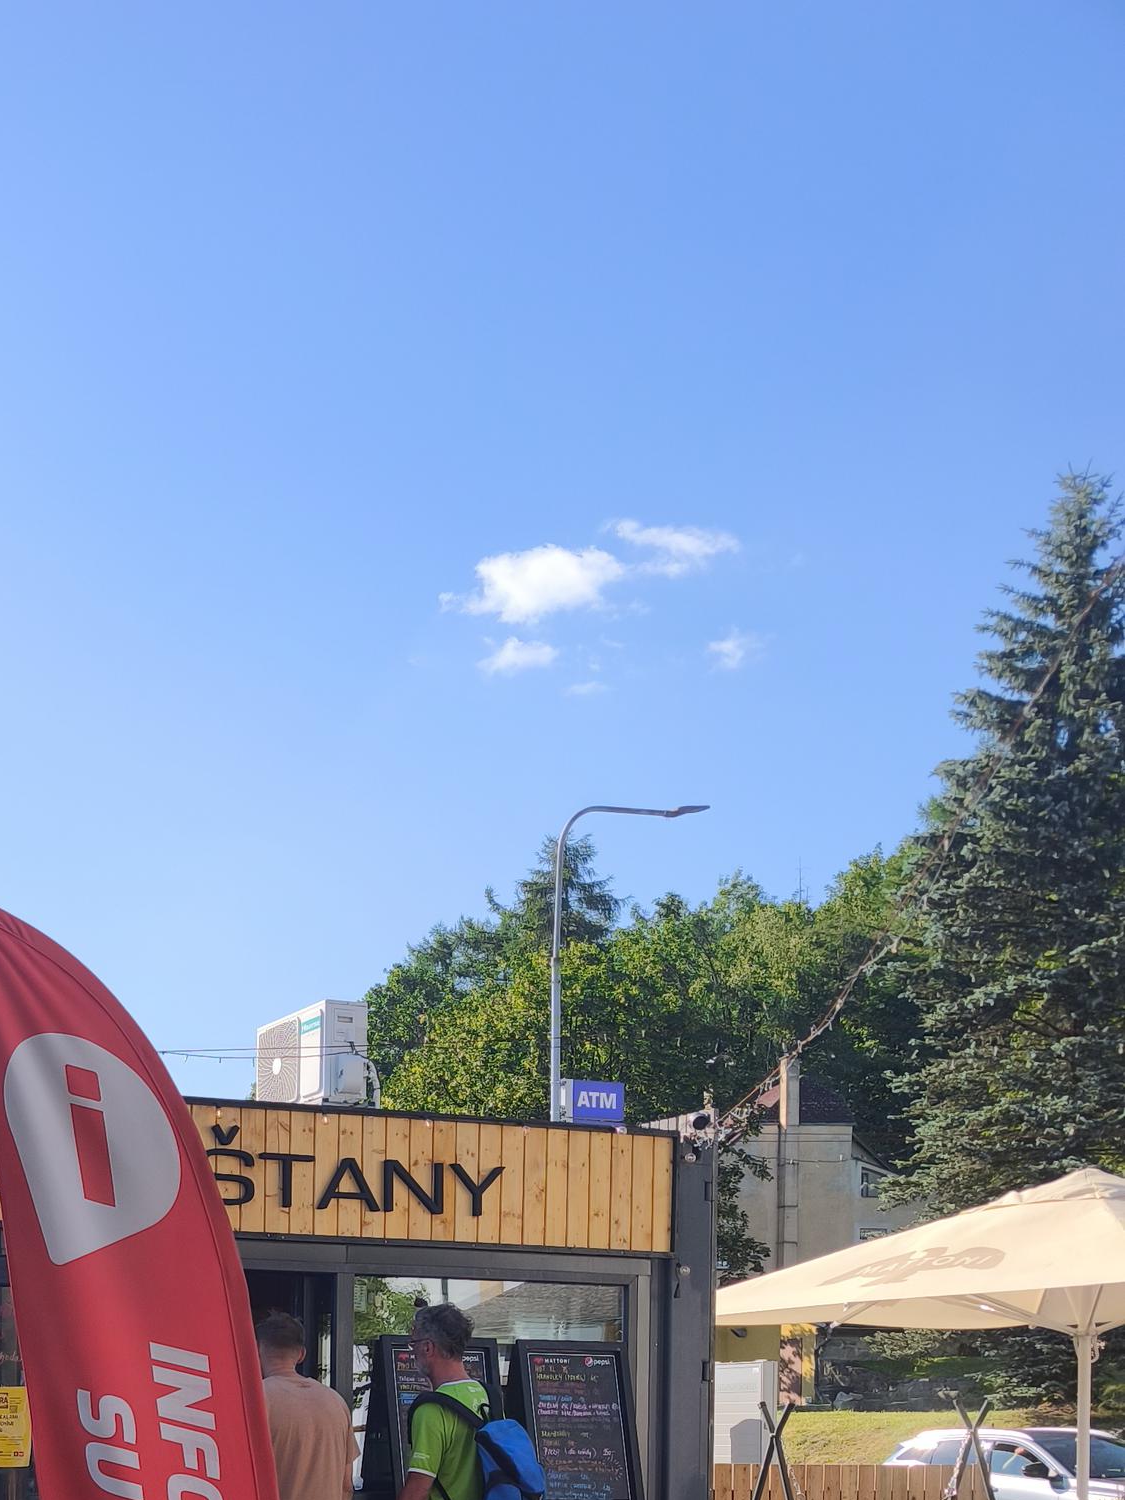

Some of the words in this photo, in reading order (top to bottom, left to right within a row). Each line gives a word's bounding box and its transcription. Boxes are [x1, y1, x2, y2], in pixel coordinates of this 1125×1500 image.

[577, 1091, 617, 1109] ATM
[206, 1124, 506, 1217] ŠTANY
[857, 1255, 993, 1275] MATTONI
